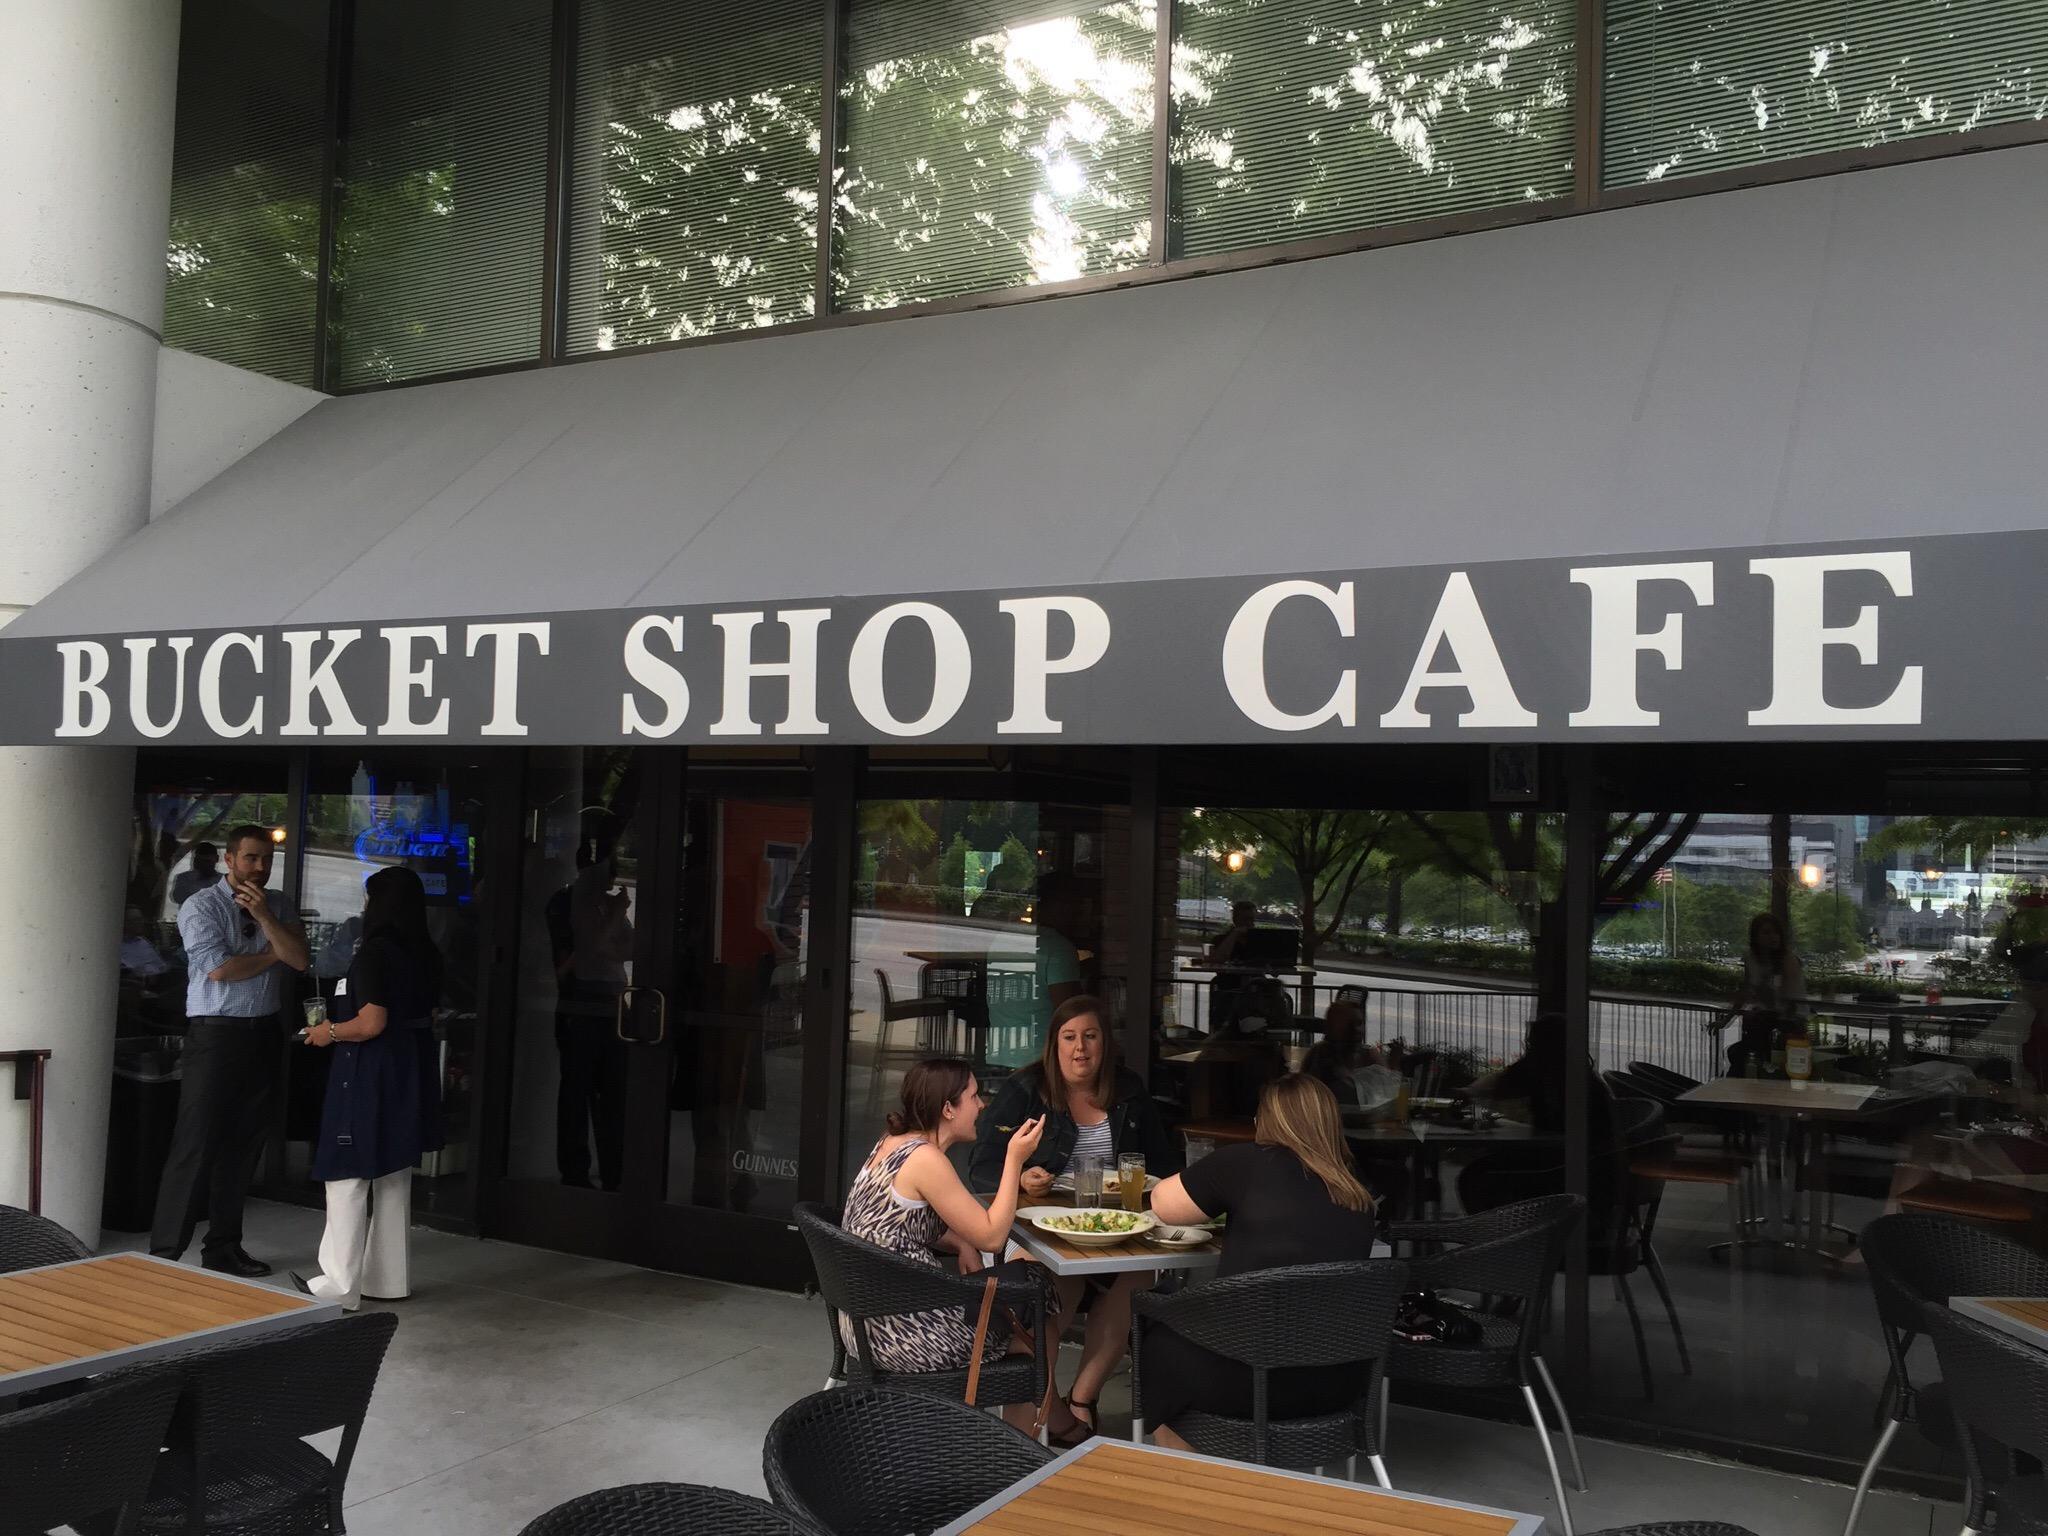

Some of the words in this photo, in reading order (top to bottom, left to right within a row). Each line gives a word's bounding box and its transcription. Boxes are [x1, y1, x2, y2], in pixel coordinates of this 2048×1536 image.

[54, 621, 551, 739] BUCKET
[622, 596, 1111, 739] SHOP
[1222, 550, 1923, 732] CAFE
[732, 1149, 799, 1178] GUINNES
